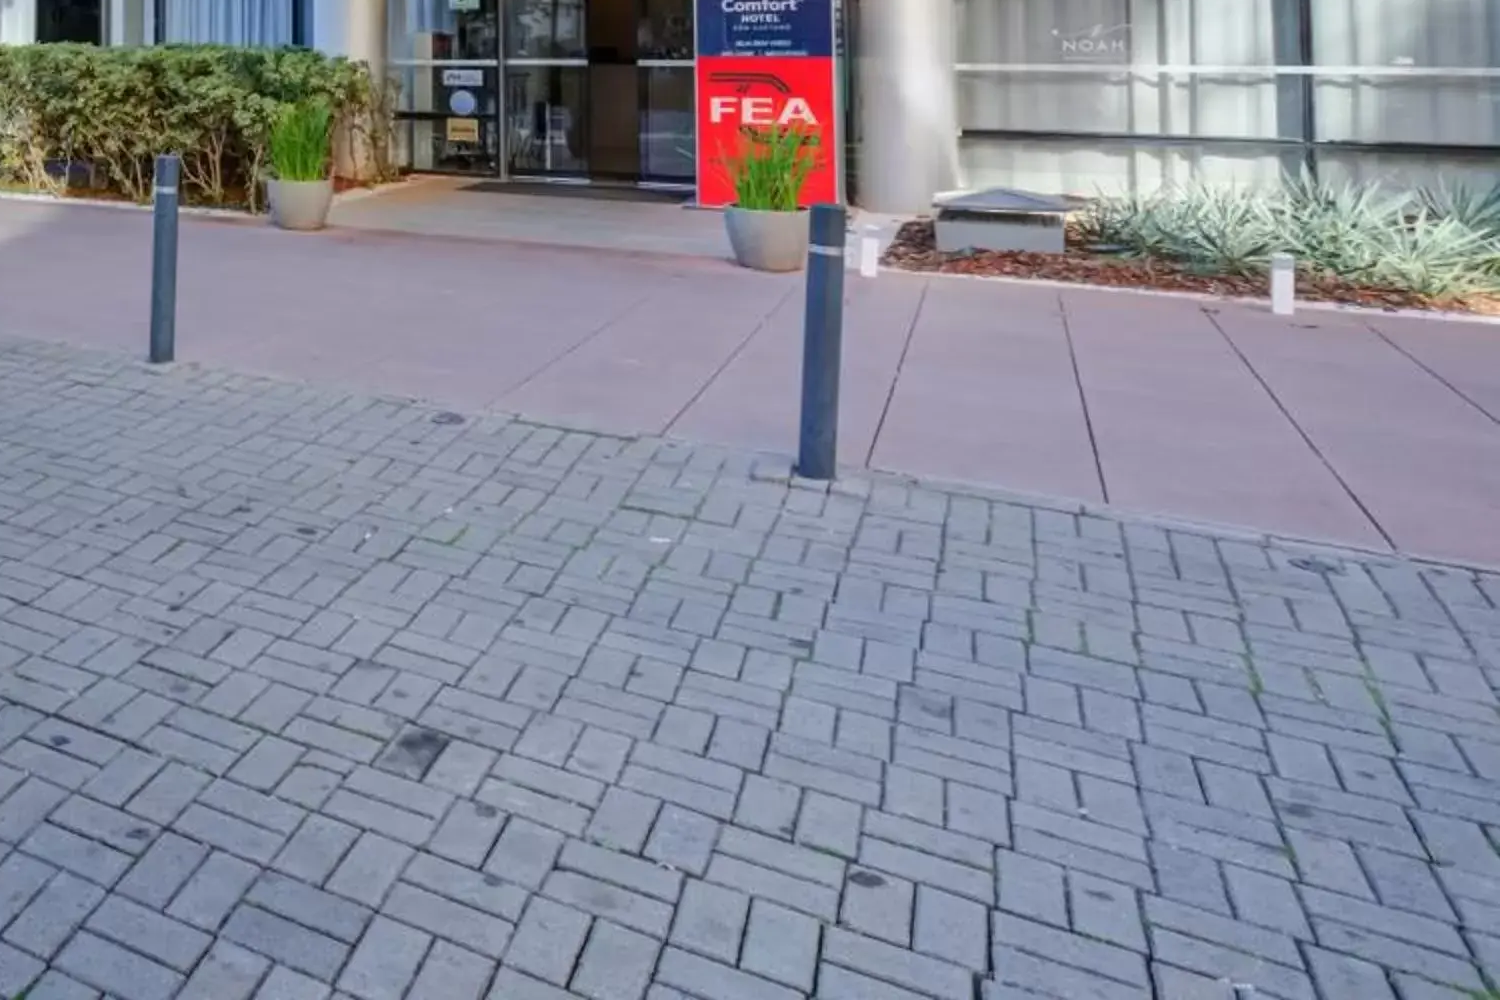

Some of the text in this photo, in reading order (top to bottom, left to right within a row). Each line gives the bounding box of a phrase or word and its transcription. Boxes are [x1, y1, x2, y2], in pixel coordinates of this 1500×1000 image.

[741, 13, 781, 23] HOTEL
[1062, 39, 1124, 53] NOAH
[709, 96, 819, 125] FEA
